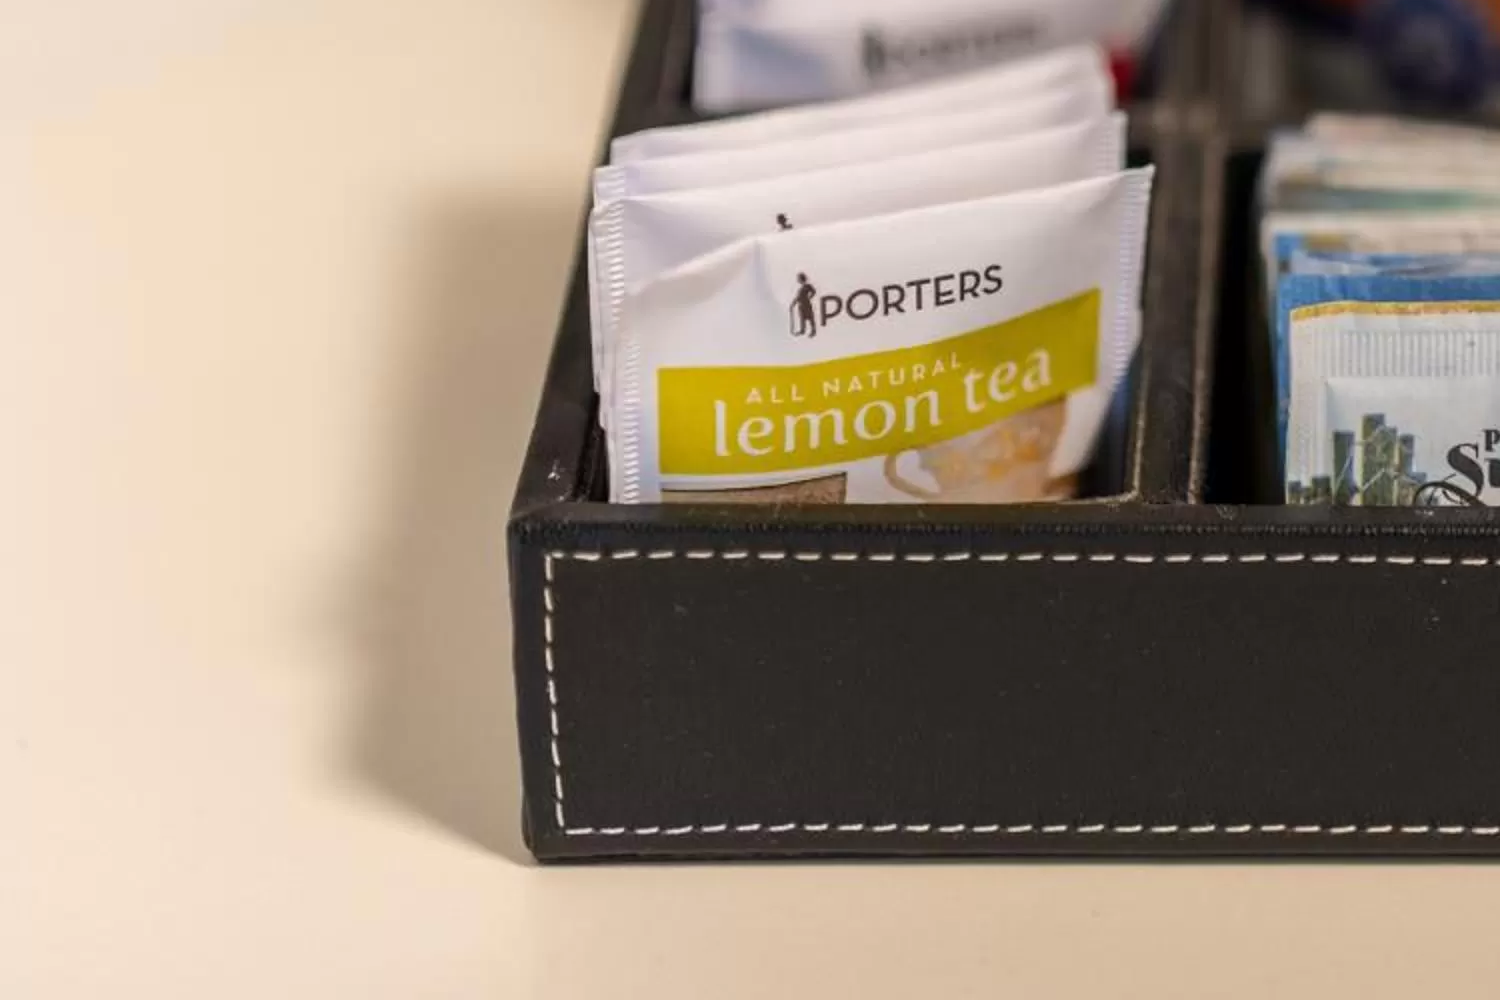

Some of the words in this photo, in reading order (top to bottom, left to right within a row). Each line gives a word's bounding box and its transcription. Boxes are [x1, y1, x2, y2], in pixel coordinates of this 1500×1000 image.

[819, 264, 1004, 328] PORTERS
[714, 387, 942, 458] lemon
[963, 348, 1053, 414] tea
[746, 382, 804, 406] ALL
[823, 352, 963, 399] NATURAL
